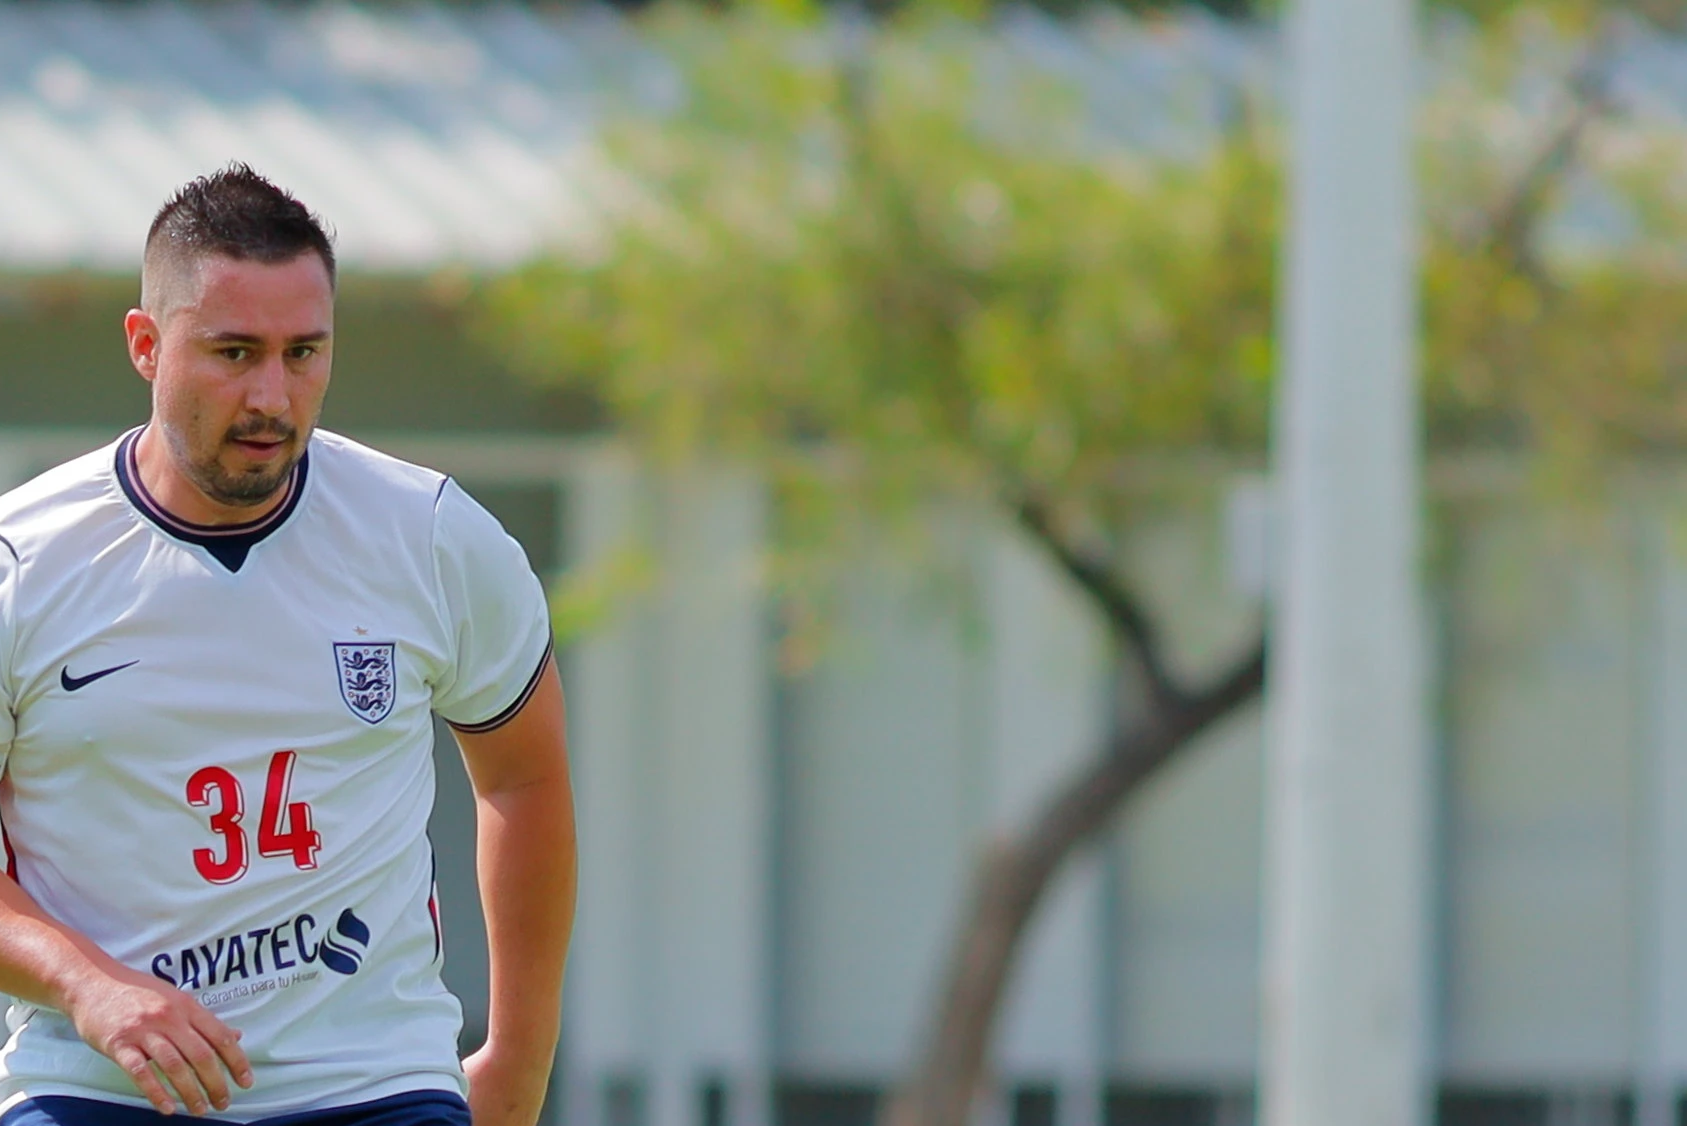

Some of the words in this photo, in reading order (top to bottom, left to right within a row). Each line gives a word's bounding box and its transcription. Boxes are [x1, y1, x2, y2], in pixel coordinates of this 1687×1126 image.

[186, 750, 322, 885] 34
[151, 913, 319, 989] SAYATEC
[251, 977, 276, 994] para
[278, 975, 290, 988] tu
